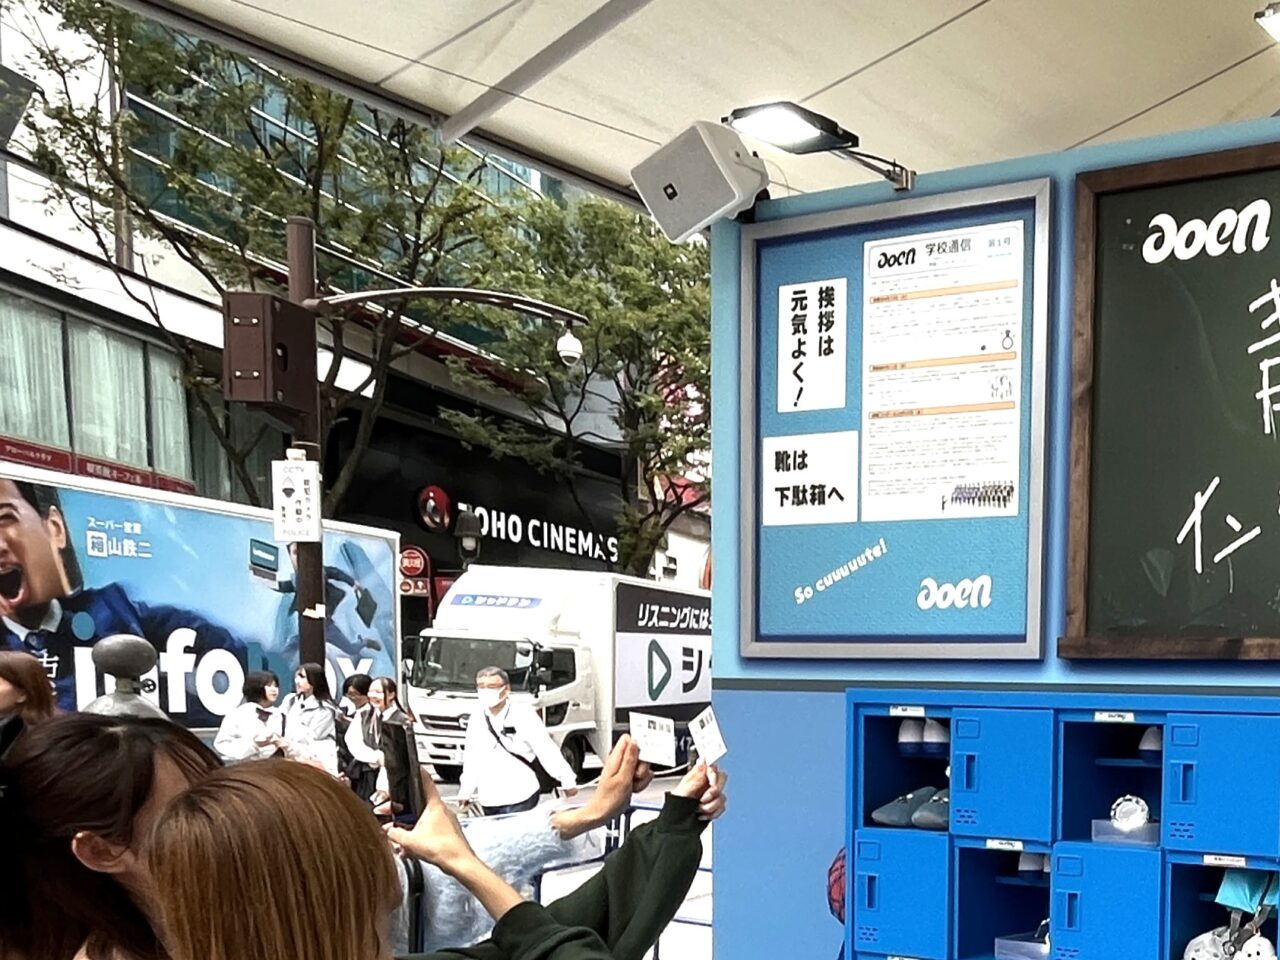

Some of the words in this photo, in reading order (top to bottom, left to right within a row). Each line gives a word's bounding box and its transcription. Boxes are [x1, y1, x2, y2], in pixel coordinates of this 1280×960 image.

[925, 238, 972, 256] 学校通信
[817, 285, 836, 357] 挨拶は
[790, 289, 808, 408] 元気よく!
[774, 450, 808, 473] 靴は
[774, 484, 845, 508] 下駄箱へ
[457, 502, 523, 543] OHO
[794, 585, 814, 605] So
[637, 603, 712, 629] リスニングには
[681, 646, 712, 694] シ
